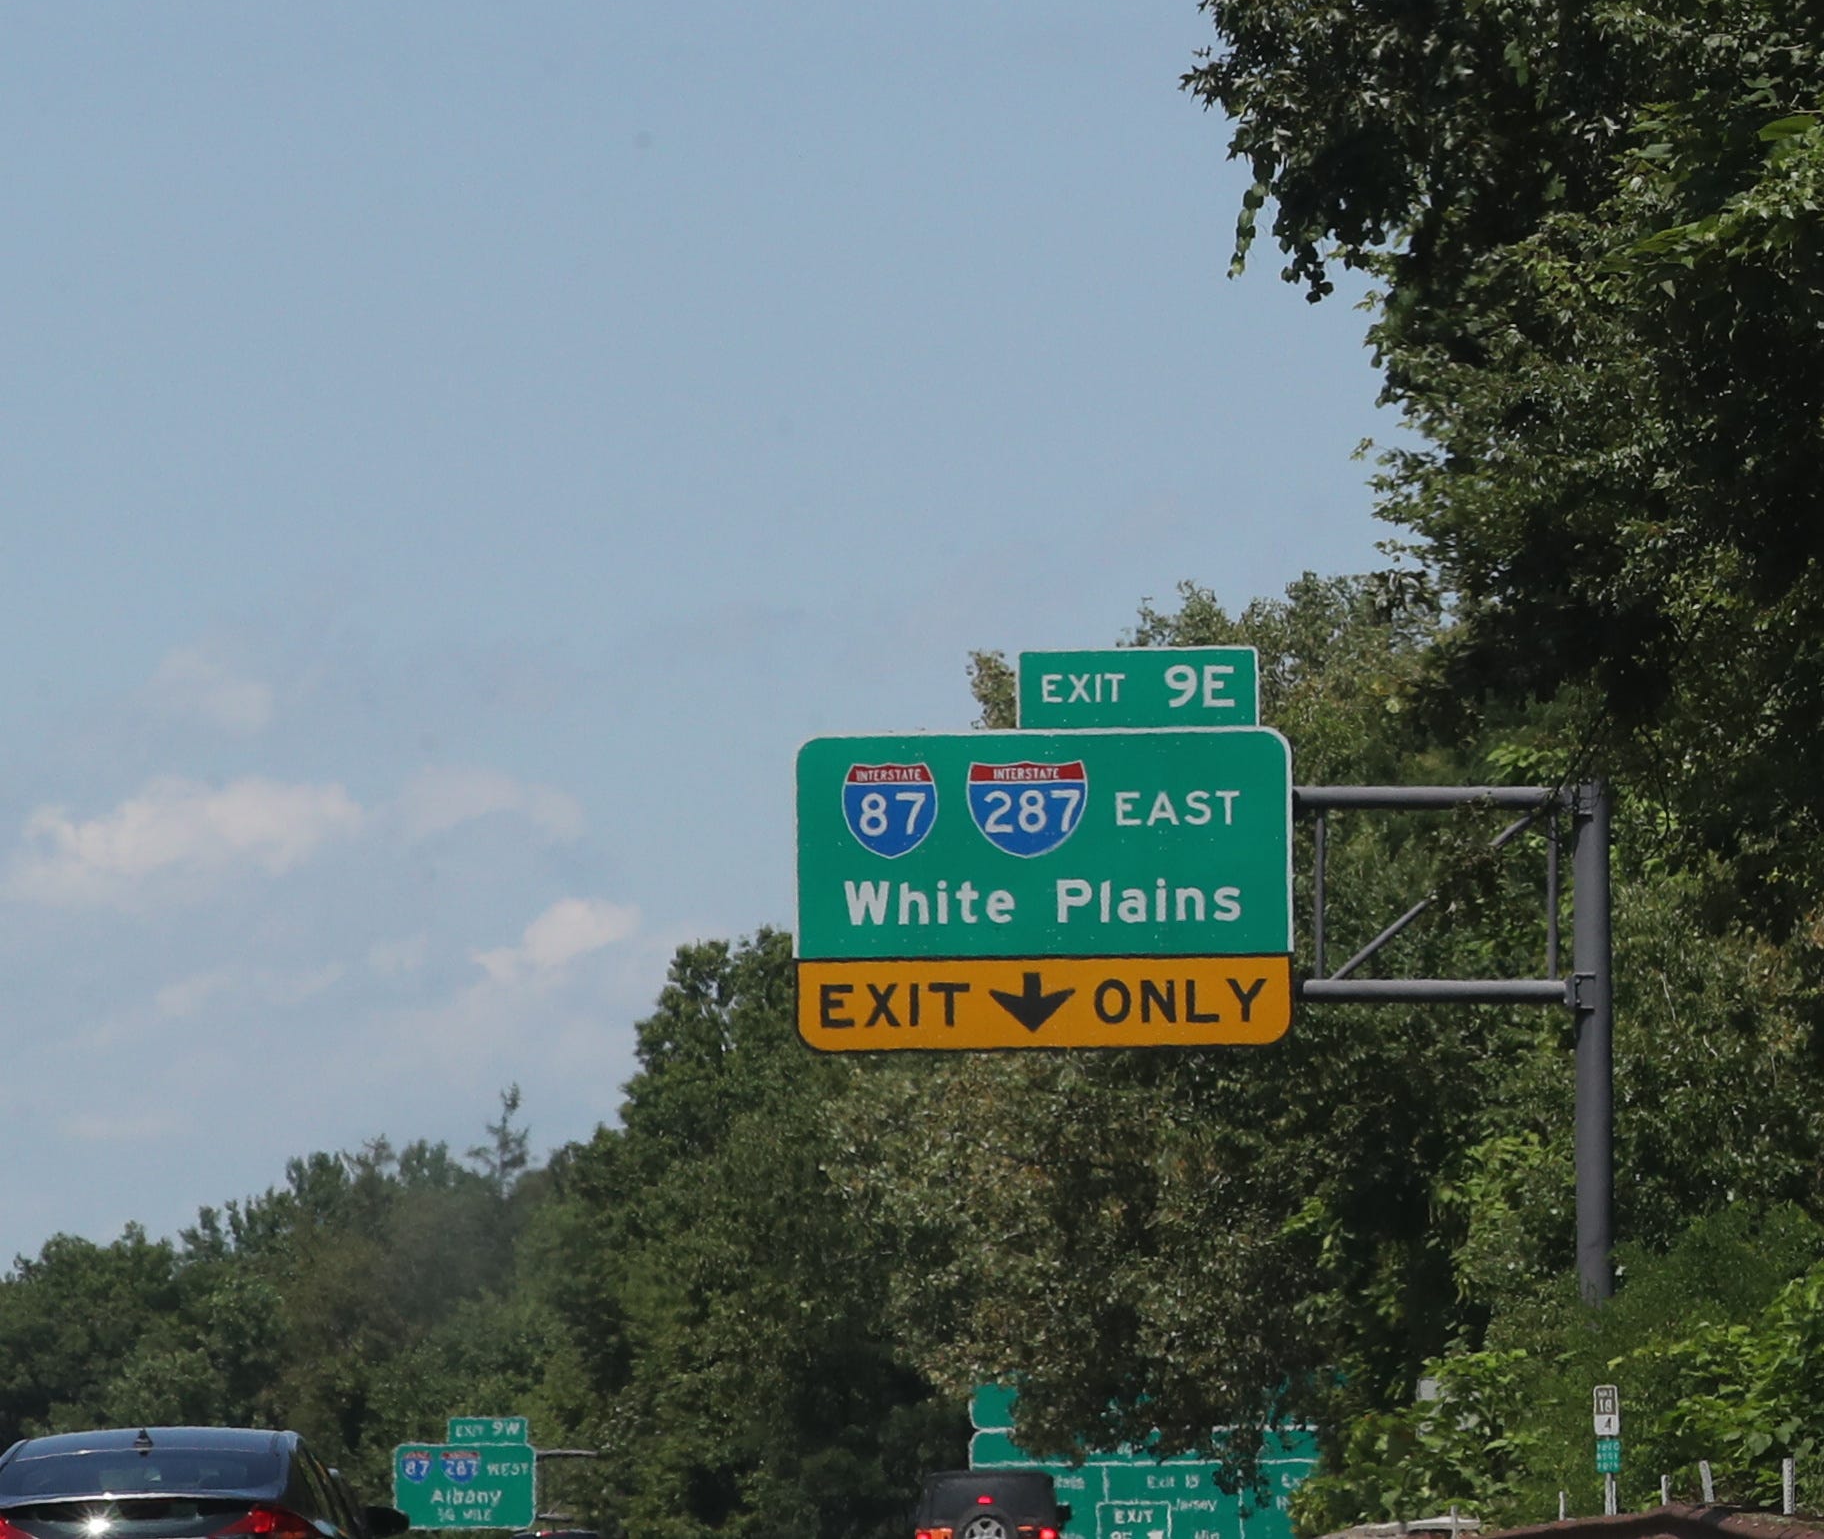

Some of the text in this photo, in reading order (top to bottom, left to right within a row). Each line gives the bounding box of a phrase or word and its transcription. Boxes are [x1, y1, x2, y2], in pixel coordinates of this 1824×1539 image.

[1041, 664, 1236, 708] EXIT 9E
[856, 769, 922, 782] INTERSTATE
[992, 767, 1060, 780] INTERSTATE
[859, 792, 927, 836] 87
[984, 789, 1081, 834] 287
[1115, 790, 1240, 826] EAST
[844, 878, 1242, 926] White Plains
[819, 977, 1268, 1030] EXIT ONLY
[455, 1421, 520, 1438] EXIT 9W
[405, 1460, 430, 1476] 87
[445, 1460, 478, 1476] 287
[486, 1463, 529, 1477] WEST
[430, 1487, 502, 1508] Albany
[1114, 1509, 1154, 1525] EXIT
